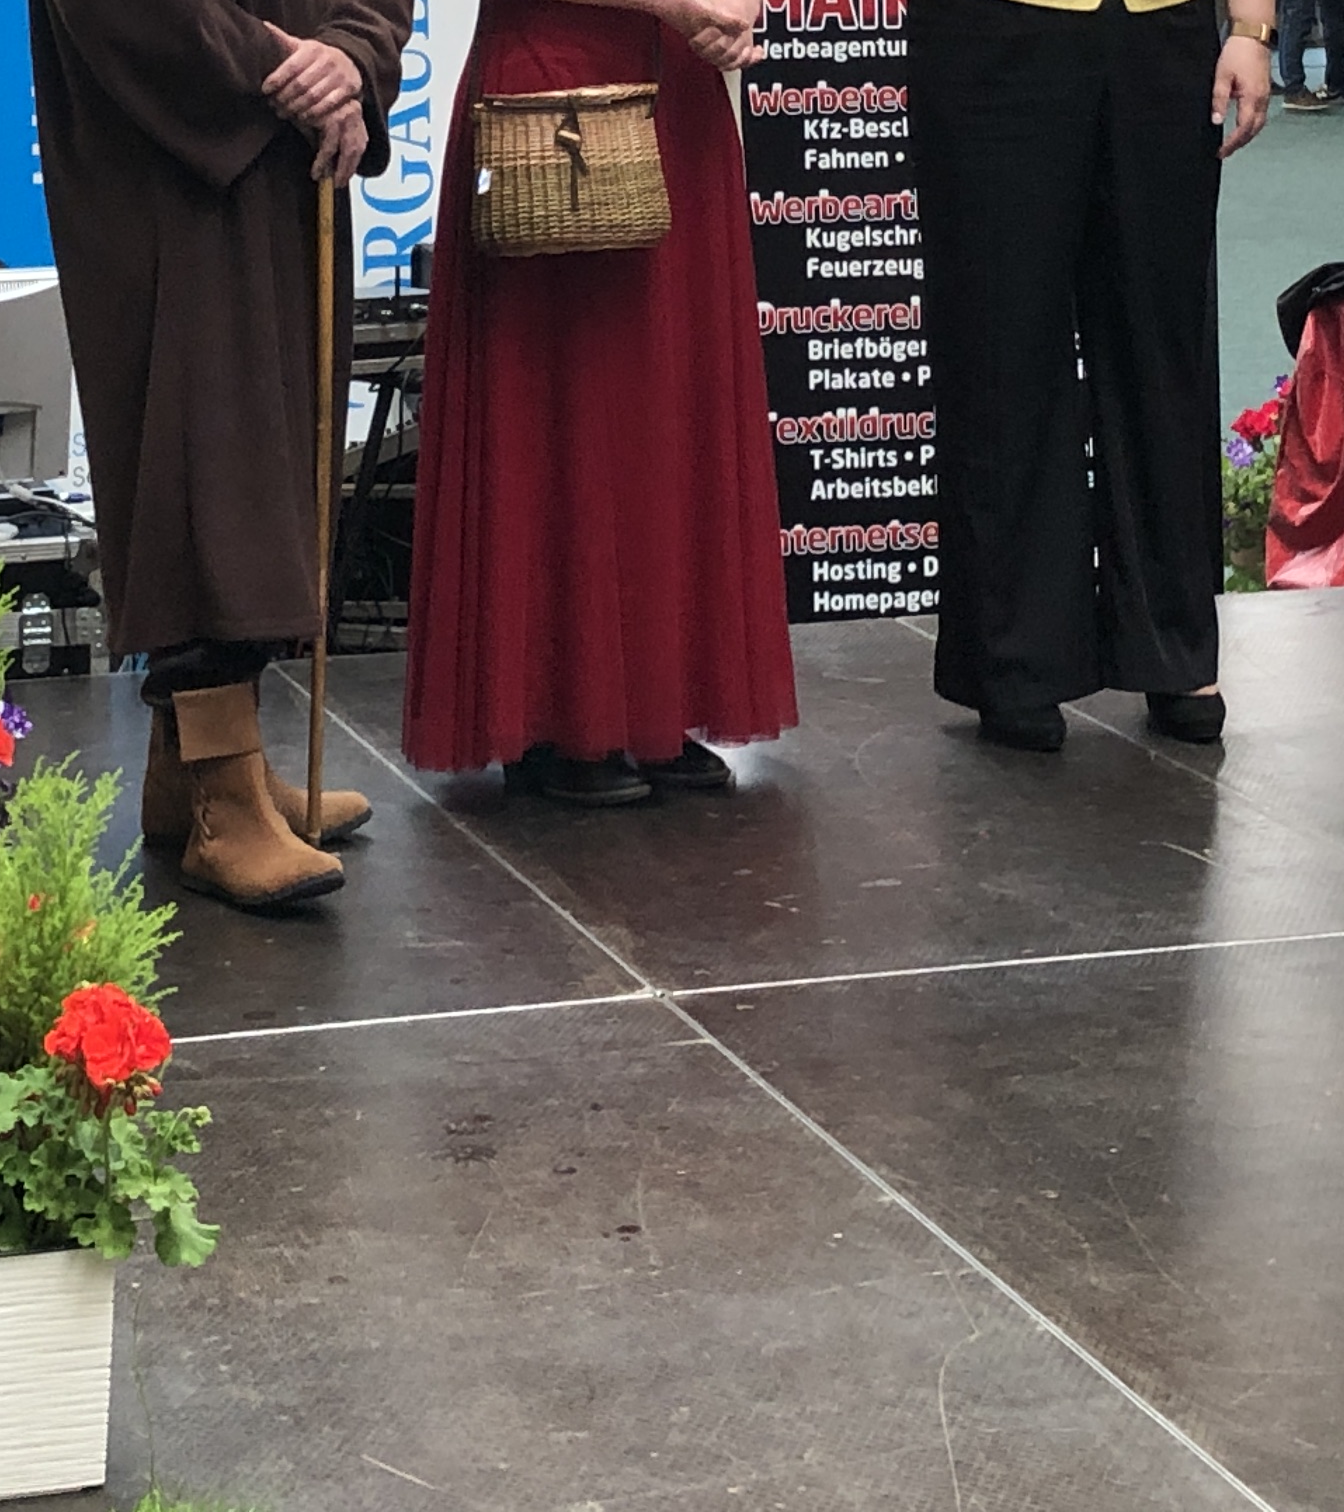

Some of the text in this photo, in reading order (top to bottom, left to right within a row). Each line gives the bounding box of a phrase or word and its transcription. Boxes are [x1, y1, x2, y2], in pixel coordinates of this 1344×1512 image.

[804, 147, 889, 170] Fahnen
[807, 257, 924, 280] Feuerzeug
[756, 295, 922, 335] Druckerei
[809, 368, 895, 390] Plakate
[768, 405, 937, 445] extildruc
[810, 447, 898, 470] T-Shirts
[812, 558, 902, 584] Hosting
